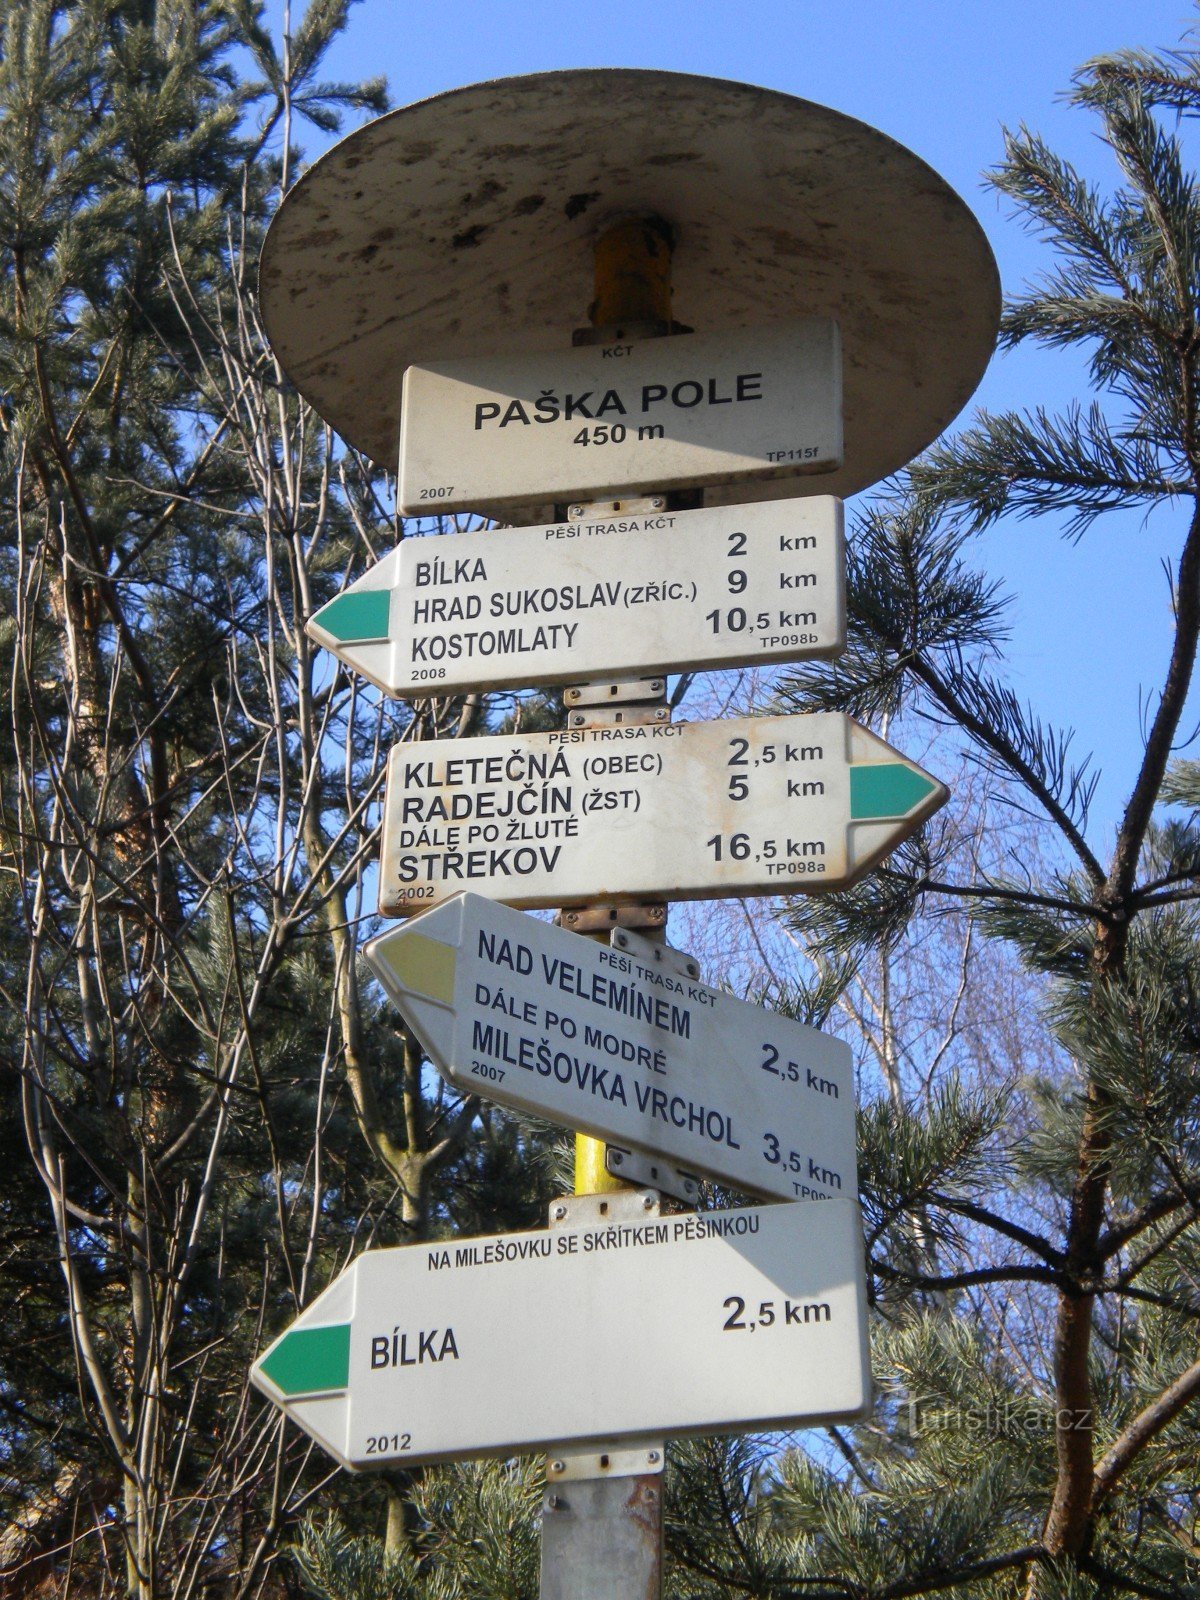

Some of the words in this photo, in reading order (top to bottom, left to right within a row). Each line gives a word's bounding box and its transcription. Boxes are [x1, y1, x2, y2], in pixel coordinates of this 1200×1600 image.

[602, 345, 634, 358] KČT
[474, 388, 626, 430] PAŠKA
[641, 372, 763, 412] POLE
[573, 423, 627, 447] 450
[638, 423, 665, 441] m
[766, 447, 818, 462] TP115f
[420, 487, 455, 500] 2007
[545, 525, 582, 541] PĚŠÍ
[584, 521, 641, 537] TRASA
[644, 517, 677, 532] KČT
[727, 532, 748, 557] 2
[779, 534, 818, 552] km
[415, 556, 488, 587] BÍLKA
[727, 569, 748, 594] 9
[779, 572, 818, 590] km
[413, 595, 482, 624] HRAD
[706, 607, 770, 634] 10,5
[779, 610, 818, 628] km
[412, 623, 579, 662] KOSTOMLATY
[760, 633, 819, 648] TP098b
[411, 668, 447, 681] 2008
[591, 727, 647, 741] TRASA
[728, 738, 776, 767] 2,5
[785, 744, 824, 762] km
[404, 746, 570, 789] KLETEČNÁ
[583, 753, 663, 781] (OBEC)
[729, 775, 749, 801] 5
[786, 778, 825, 796] km
[402, 782, 572, 824] RADEJČÍN
[581, 788, 641, 816] (ŽST)
[400, 825, 460, 849] DÁLE
[468, 824, 500, 844] PO
[505, 818, 579, 841] ŽLUTÉ
[707, 833, 777, 862] 16,5
[787, 839, 825, 857] km
[398, 845, 561, 882] STŘEKOV
[765, 861, 826, 875] TP098a
[398, 886, 435, 899] 2002
[478, 929, 533, 976] NAD
[541, 953, 691, 1039] VELEMÍNEM
[599, 951, 632, 975] PĚŠÍ
[636, 966, 684, 996] TRASA
[688, 983, 717, 1009] KČT
[475, 983, 539, 1025] DÁLE
[545, 1010, 578, 1039] PO
[584, 1025, 667, 1075] MODRÉ
[471, 1060, 506, 1083] 2007
[472, 1020, 627, 1107] MILEŠOVKA
[635, 1080, 740, 1150] VRCHOL
[761, 1043, 799, 1083] 2,5
[806, 1069, 839, 1099] km
[763, 1133, 801, 1173] 3,5
[808, 1159, 842, 1190] km
[428, 1252, 451, 1271] NA
[455, 1238, 552, 1268] MILEŠOVKU
[557, 1236, 579, 1255] SE
[583, 1222, 668, 1251] SKŘÍTKEM
[673, 1215, 761, 1243] PĚŠINKOU
[723, 1296, 777, 1333] 2,5
[784, 1298, 832, 1326] km
[371, 1326, 460, 1371] BÍLKA
[365, 1433, 412, 1454] 2012
